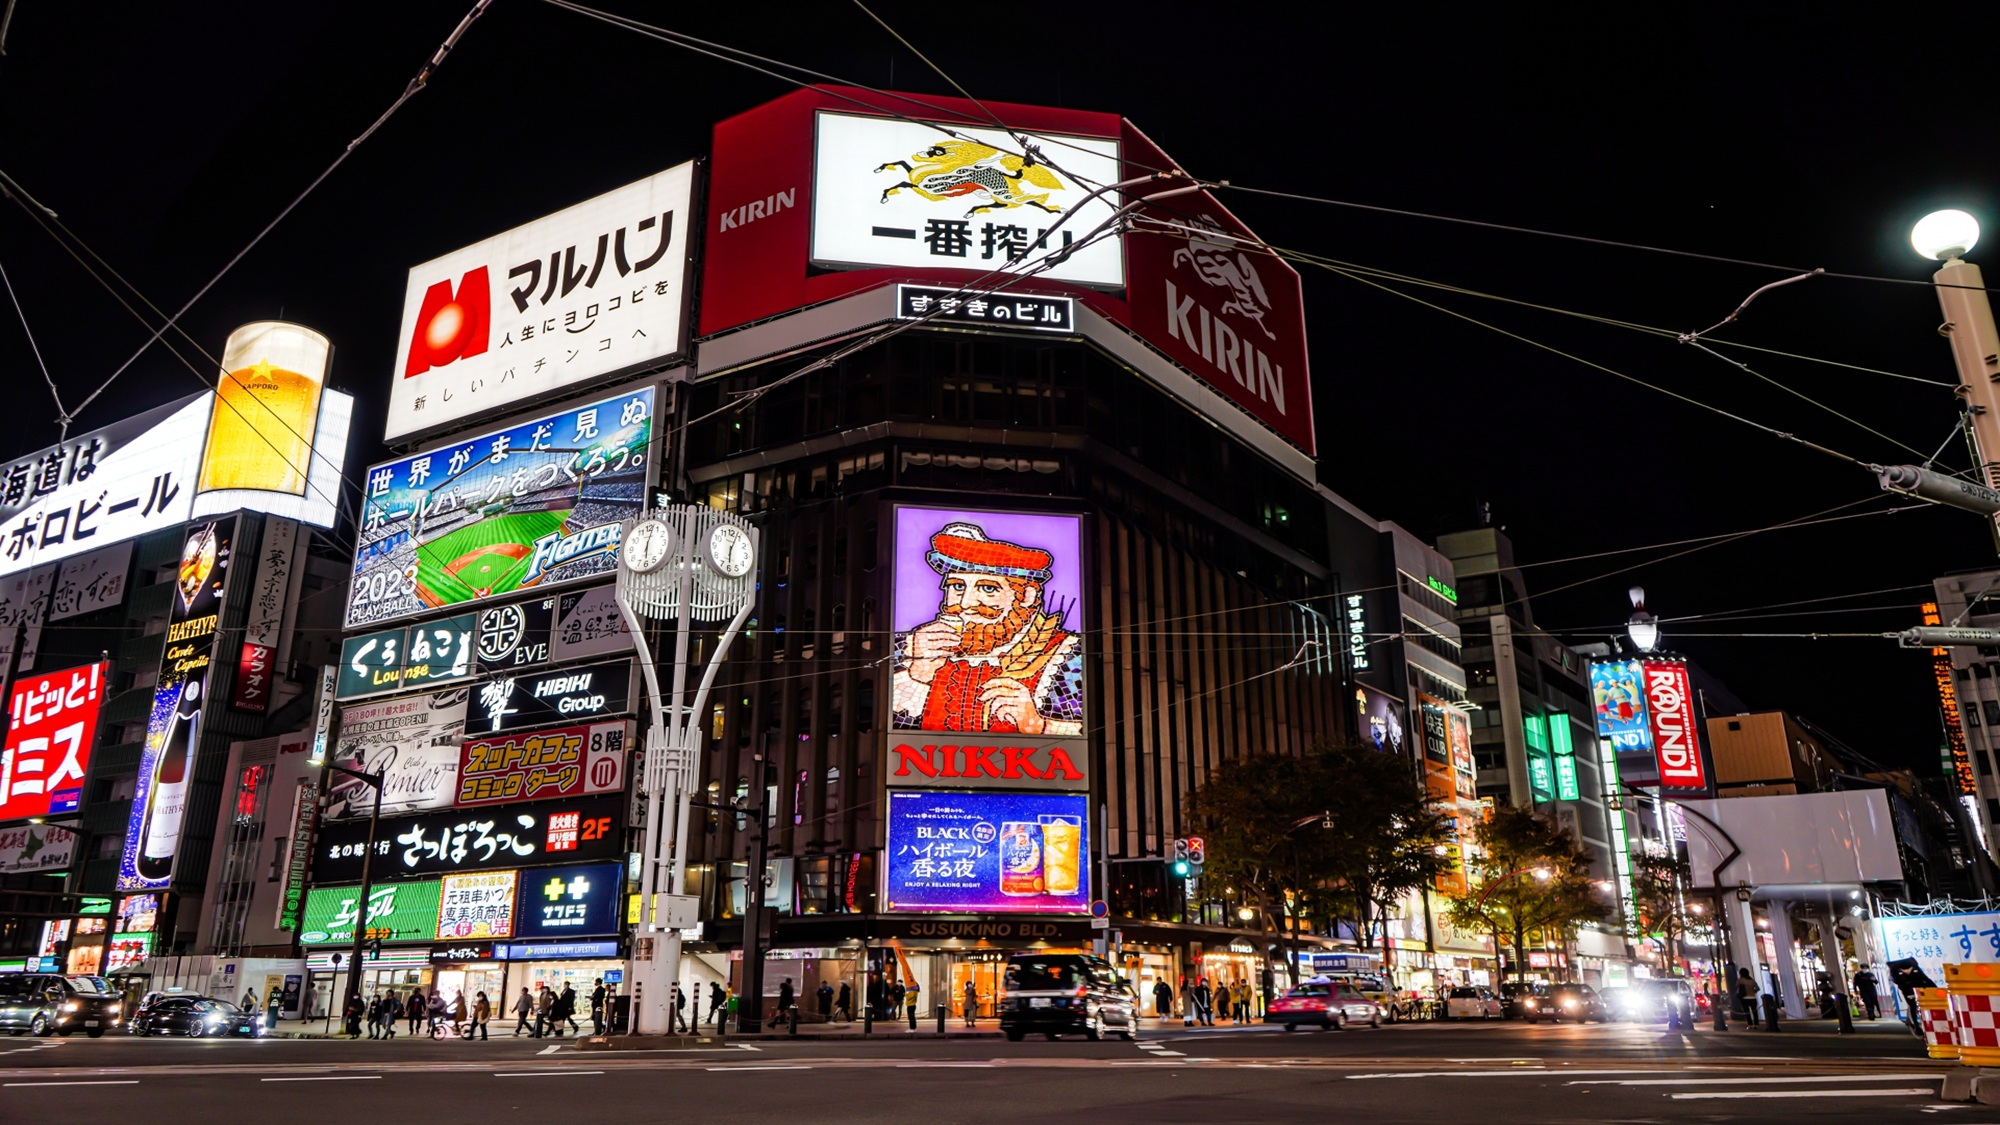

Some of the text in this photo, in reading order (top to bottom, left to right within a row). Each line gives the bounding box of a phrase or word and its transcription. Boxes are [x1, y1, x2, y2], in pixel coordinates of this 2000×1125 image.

[719, 187, 796, 233] KIRIN
[871, 217, 1073, 265] 一番搾り
[508, 209, 674, 314] マルハン
[500, 280, 669, 349] 人生にヨロコビを
[909, 295, 1062, 323] すすきのビル
[1165, 278, 1286, 416] KIRIN
[413, 328, 647, 412] 新しいパチンコへ
[370, 396, 648, 500] 世界がまだ見ぬ
[364, 441, 644, 534] ボールパークをつくろう。
[0, 470, 181, 561] ポロビール
[352, 564, 419, 606] 2023
[350, 597, 413, 620] PLAY BALL
[542, 599, 554, 610] 8F
[562, 597, 576, 610] 2F
[562, 612, 619, 645] 温野菜
[1347, 594, 1369, 669] すすきのビル
[351, 628, 453, 679] くろねこ
[514, 642, 549, 665] EVE
[244, 646, 269, 699] カラオケ
[373, 664, 430, 686] Lounge
[534, 673, 593, 698] HIBIKI
[558, 694, 605, 714] Group
[1425, 711, 1445, 738] 快活
[463, 729, 625, 775] ネットカフェ 8階
[1428, 736, 1447, 756] CLUB
[892, 743, 1085, 781] NIKKA
[302, 788, 319, 800] 24H
[461, 765, 580, 802] コミック ダーツ
[397, 814, 611, 868] さっぽろっこ 2F
[917, 826, 970, 839] BLACK
[329, 840, 391, 859] 北の味行
[897, 842, 989, 858] ハイボール
[909, 858, 977, 878] 香る夜
[446, 888, 505, 905] 元祖串かつ
[444, 904, 510, 922] 恵美須商店
[543, 904, 587, 918] サツドラ
[909, 922, 1062, 938] SUSUKINO BLD.
[1893, 927, 1945, 941] ずっと好き。
[1897, 945, 1948, 958] もっと好き。
